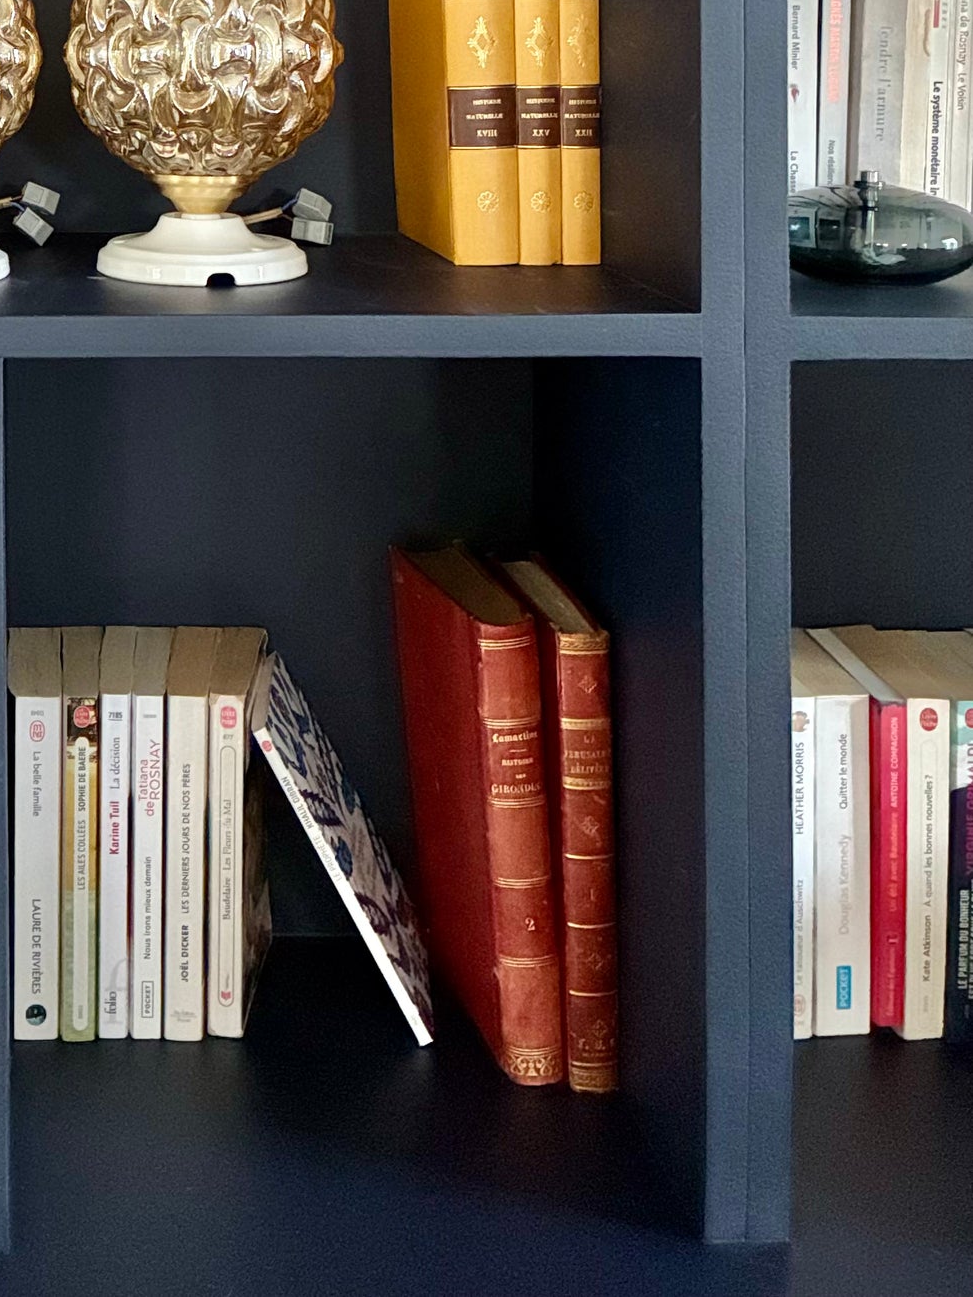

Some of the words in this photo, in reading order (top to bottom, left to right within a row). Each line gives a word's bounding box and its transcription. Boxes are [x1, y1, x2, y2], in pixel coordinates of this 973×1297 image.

[791, 5, 800, 39] Bernard
[960, 15, 970, 27] de
[790, 41, 800, 70] Minier
[933, 81, 943, 93] Le
[957, 72, 967, 83] Le
[956, 86, 967, 110] Voisin
[930, 95, 943, 134] système
[532, 129, 550, 137] XXV
[828, 140, 836, 153] Nos
[790, 151, 798, 161] La
[930, 136, 942, 185] monétaire
[789, 163, 798, 194] Chasse
[32, 751, 41, 761] La
[109, 736, 120, 776] décision
[839, 733, 848, 765] monde
[890, 716, 899, 769] COMPAGNON
[78, 746, 87, 771] BAERE
[149, 738, 161, 801] ROSNAY
[794, 742, 804, 787] MORRIS
[839, 767, 847, 776] le
[32, 763, 42, 785] belle
[78, 773, 86, 782] DE
[109, 779, 120, 790] La
[138, 759, 149, 802] Tatiana
[32, 787, 42, 817] famille
[78, 785, 86, 811] SOPHIE
[183, 790, 191, 811] NOS
[838, 778, 848, 810] Quitter
[890, 771, 899, 808] ANTOINE
[925, 782, 933, 821] nouvelles
[109, 800, 120, 820] Tuil
[144, 801, 155, 817] de
[183, 812, 191, 824] DE
[223, 799, 232, 816] Mal
[296, 804, 314, 829] KHALIL
[794, 788, 804, 835] HEATHER
[77, 819, 86, 852] COLLÉES
[109, 822, 120, 855] Karine
[182, 826, 191, 855] JOURS
[924, 823, 933, 855] bonnes
[78, 853, 86, 875] AILES
[144, 856, 153, 886] demain
[223, 856, 232, 870] Les
[839, 834, 853, 885] Kennedy
[924, 856, 932, 868] les
[78, 878, 86, 890] LES
[182, 856, 191, 897] DERNIERS
[925, 869, 934, 898] quand
[144, 889, 152, 919] mieux
[182, 900, 190, 914] LES
[223, 877, 232, 921] Baudelaire
[794, 878, 804, 932] d'Auschwitz
[838, 887, 852, 936] Douglas
[958, 889, 968, 928] BONHEUR
[32, 898, 42, 932] LAURE
[524, 917, 536, 931] 2
[32, 934, 42, 949] DE
[182, 924, 190, 958] DICKER
[923, 915, 932, 957] Atkinson
[959, 930, 968, 942] DU
[143, 944, 151, 960] Nous
[959, 945, 968, 977] PARFUM
[32, 951, 43, 994] RIVIÈRES
[181, 959, 189, 983] JOËL
[922, 959, 931, 982] Kate
[959, 979, 968, 989] LE
[104, 991, 117, 1015] folio
